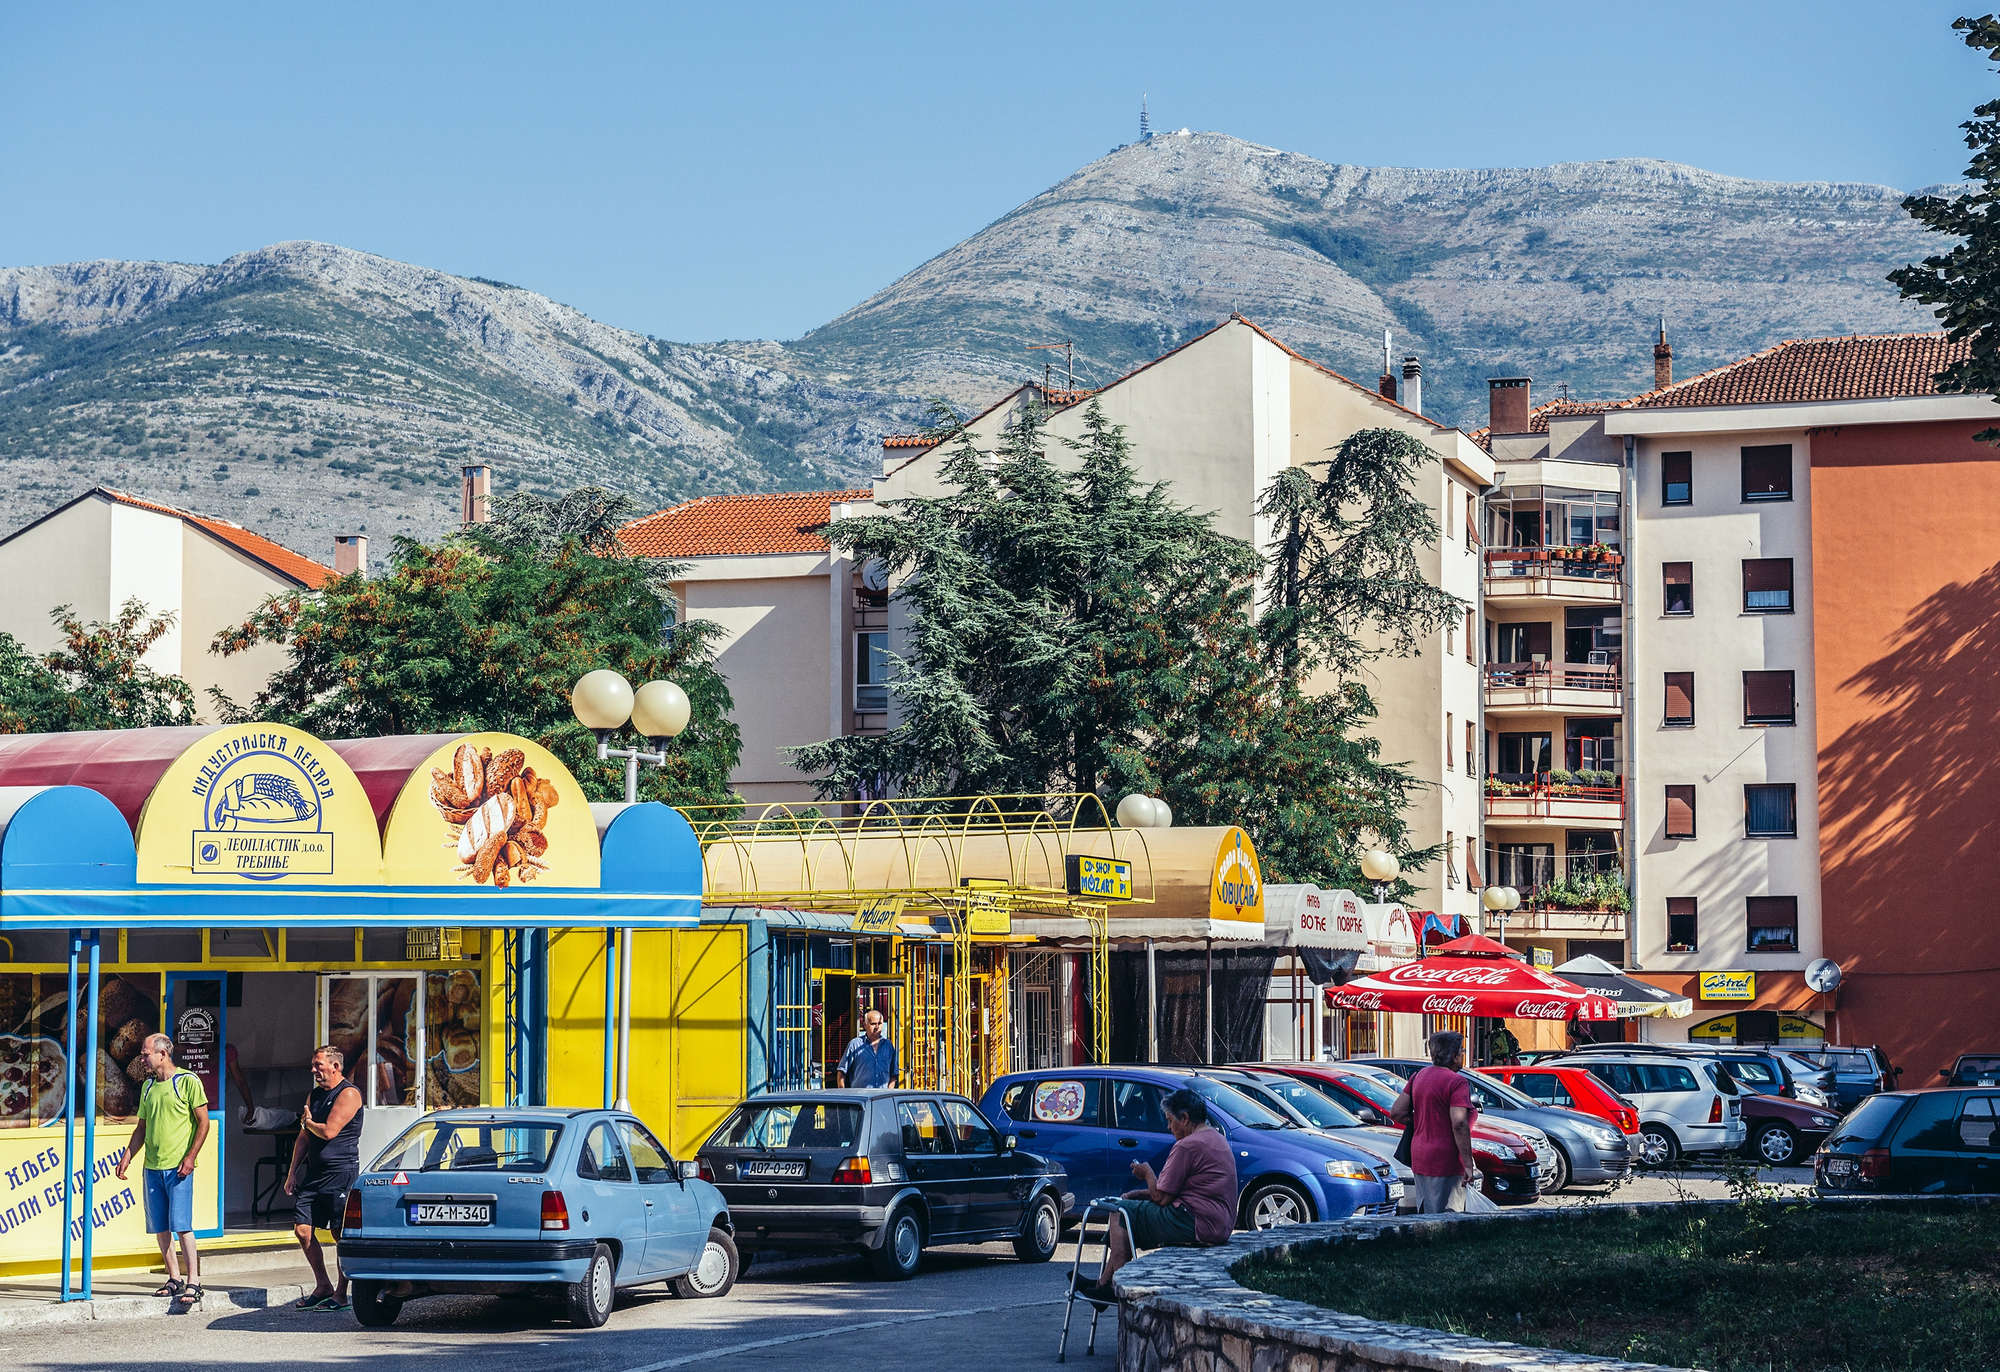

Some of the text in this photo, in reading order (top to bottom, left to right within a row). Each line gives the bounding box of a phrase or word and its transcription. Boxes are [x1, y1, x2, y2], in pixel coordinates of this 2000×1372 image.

[191, 733, 335, 800] ИНДУСТРИЈСКА ПЕКАРА
[223, 838, 301, 852] ЛЕОПЛАСТИК
[236, 855, 290, 868] ТРЕБИЊЕ
[1096, 861, 1111, 874] SHOP
[1081, 874, 1114, 894] MOZART
[1389, 964, 1518, 985] Coca-Cola
[1332, 990, 1385, 1010] Coca-Cola
[1422, 993, 1477, 1014] Coca-Cola
[1515, 1000, 1571, 1019] Coca-Cola
[0, 1195, 42, 1234] ОПЛИ
[419, 1206, 488, 1221] J74-M-340
